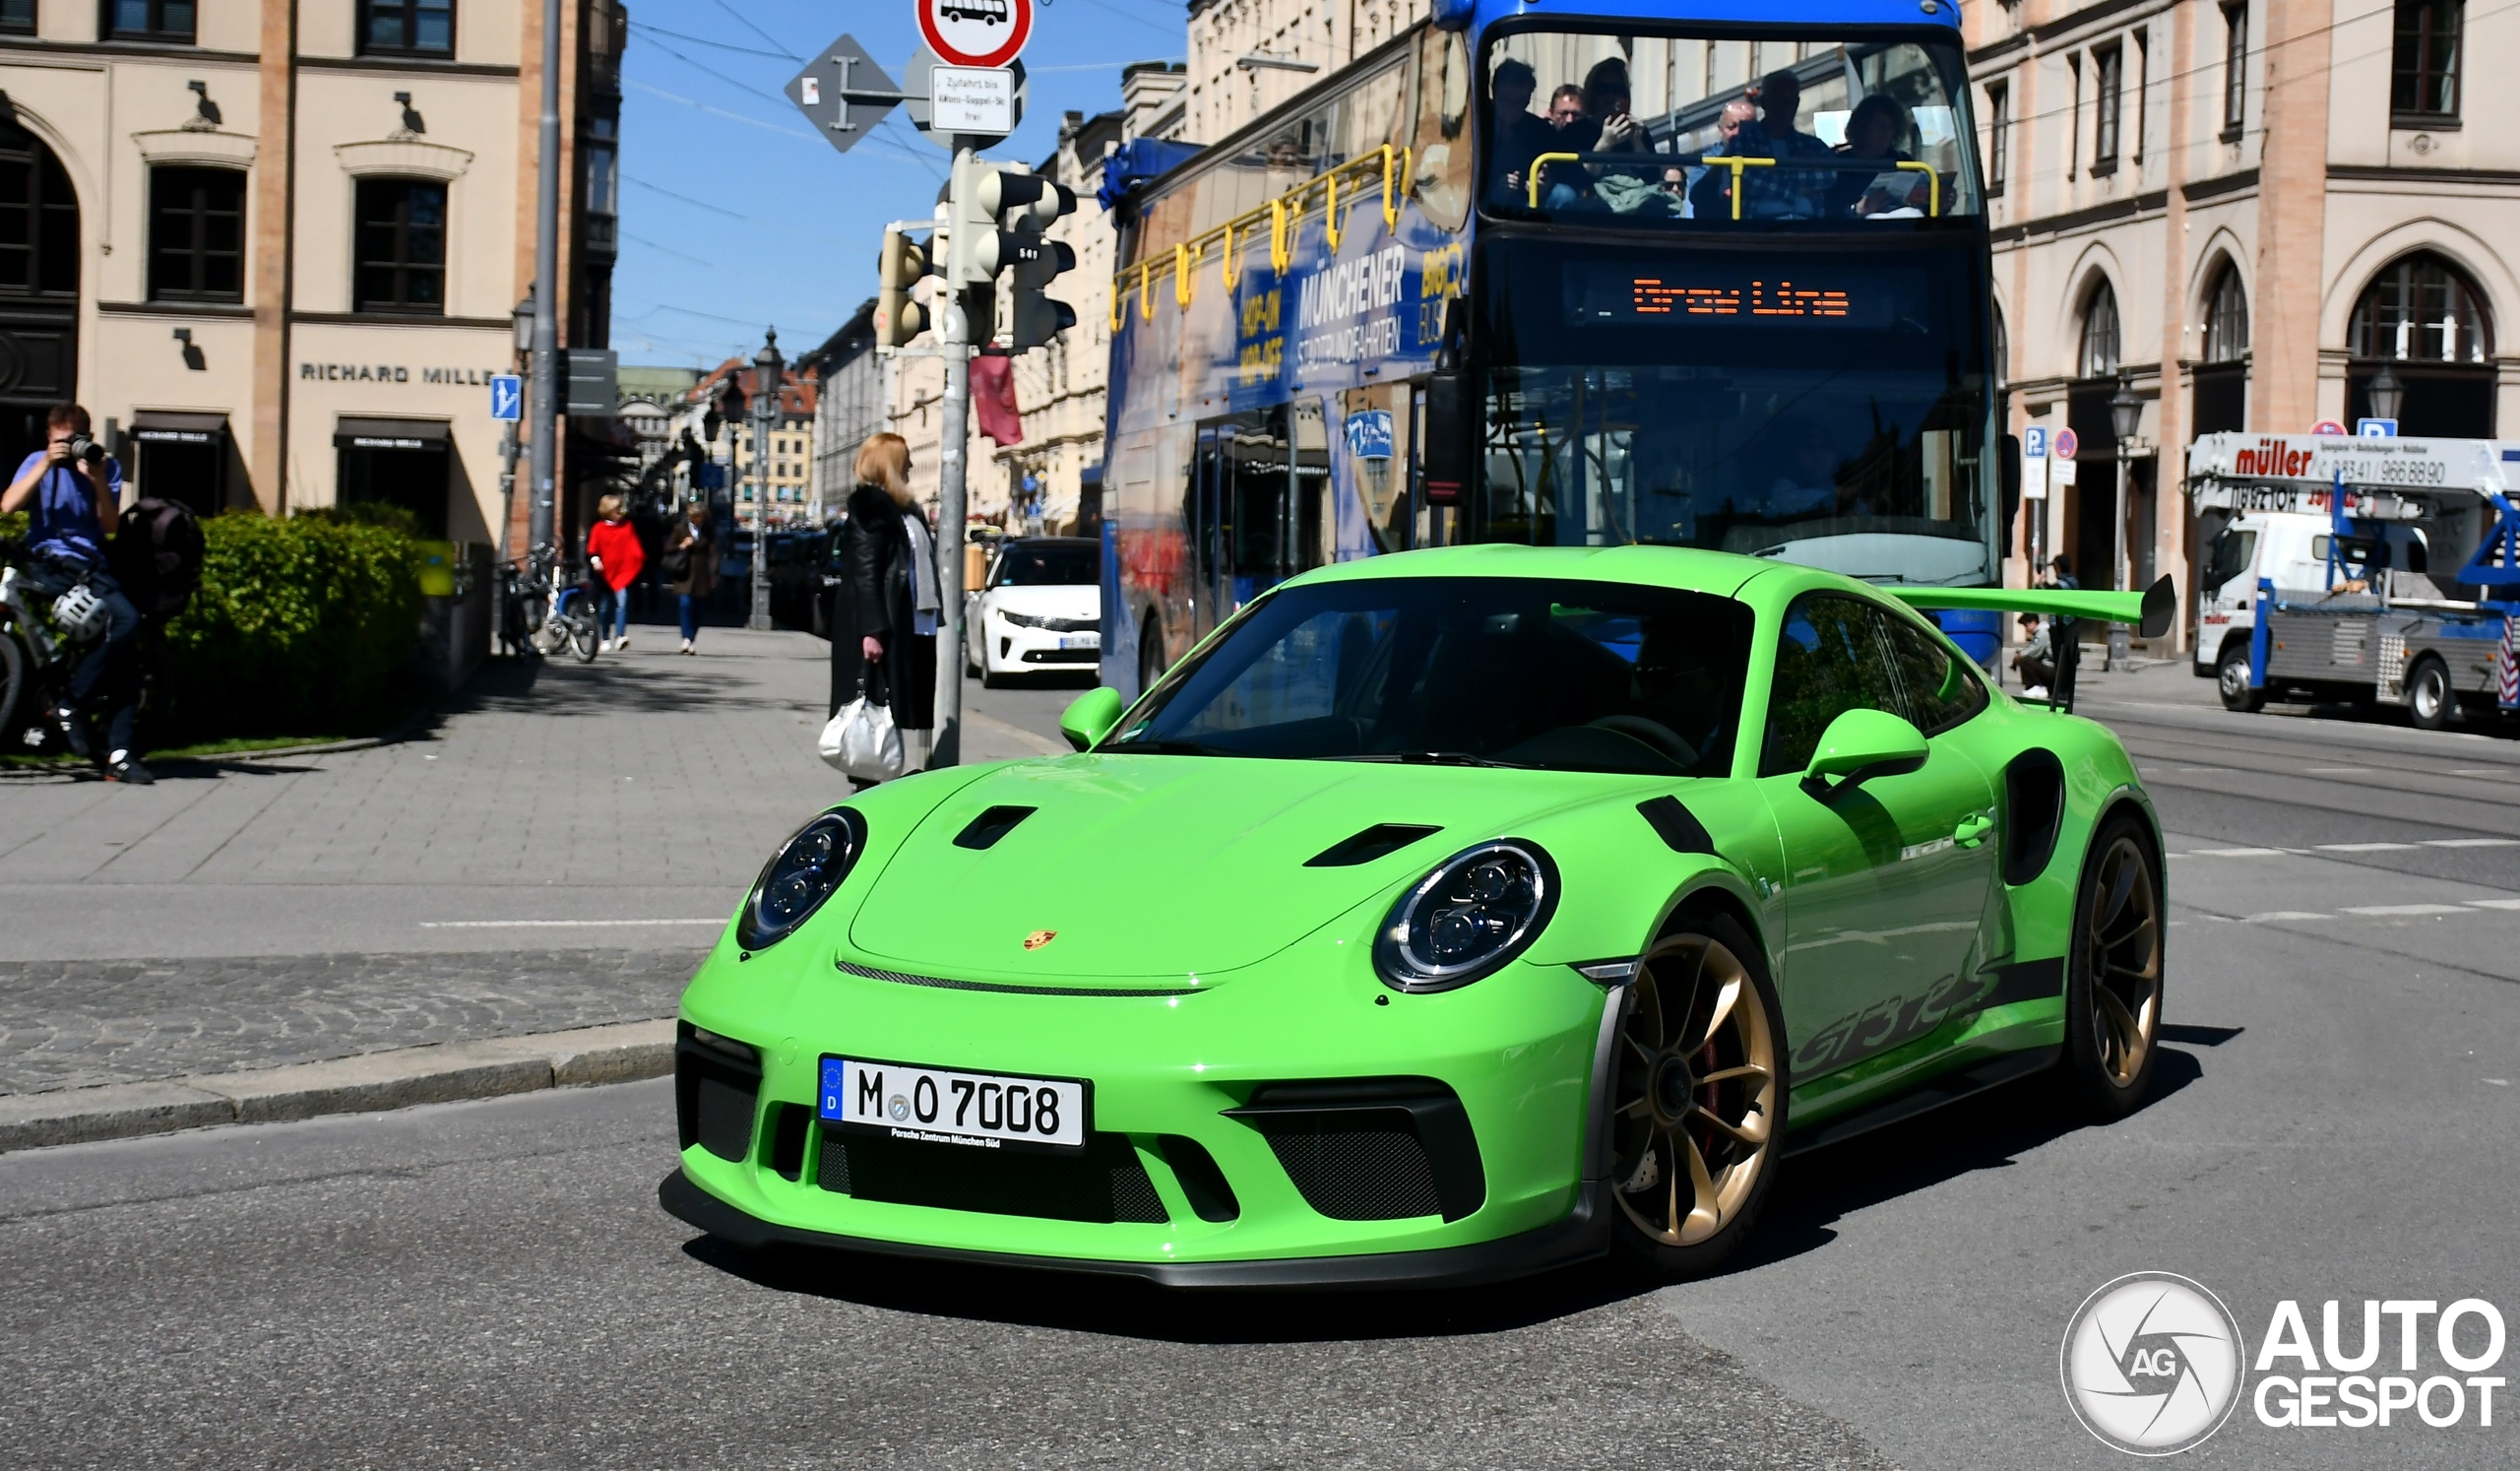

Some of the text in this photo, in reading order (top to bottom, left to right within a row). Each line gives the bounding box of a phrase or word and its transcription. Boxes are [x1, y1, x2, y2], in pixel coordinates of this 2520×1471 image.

[1298, 243, 1406, 331] MÜNCHENER
[1751, 281, 1850, 316] Line
[300, 362, 409, 383] RICHARD
[2235, 438, 2312, 477] müller
[827, 1095, 837, 1111] D
[858, 1068, 1060, 1135] M O 7008
[891, 1127, 1001, 1148] Porsche Zentrum München Süd
